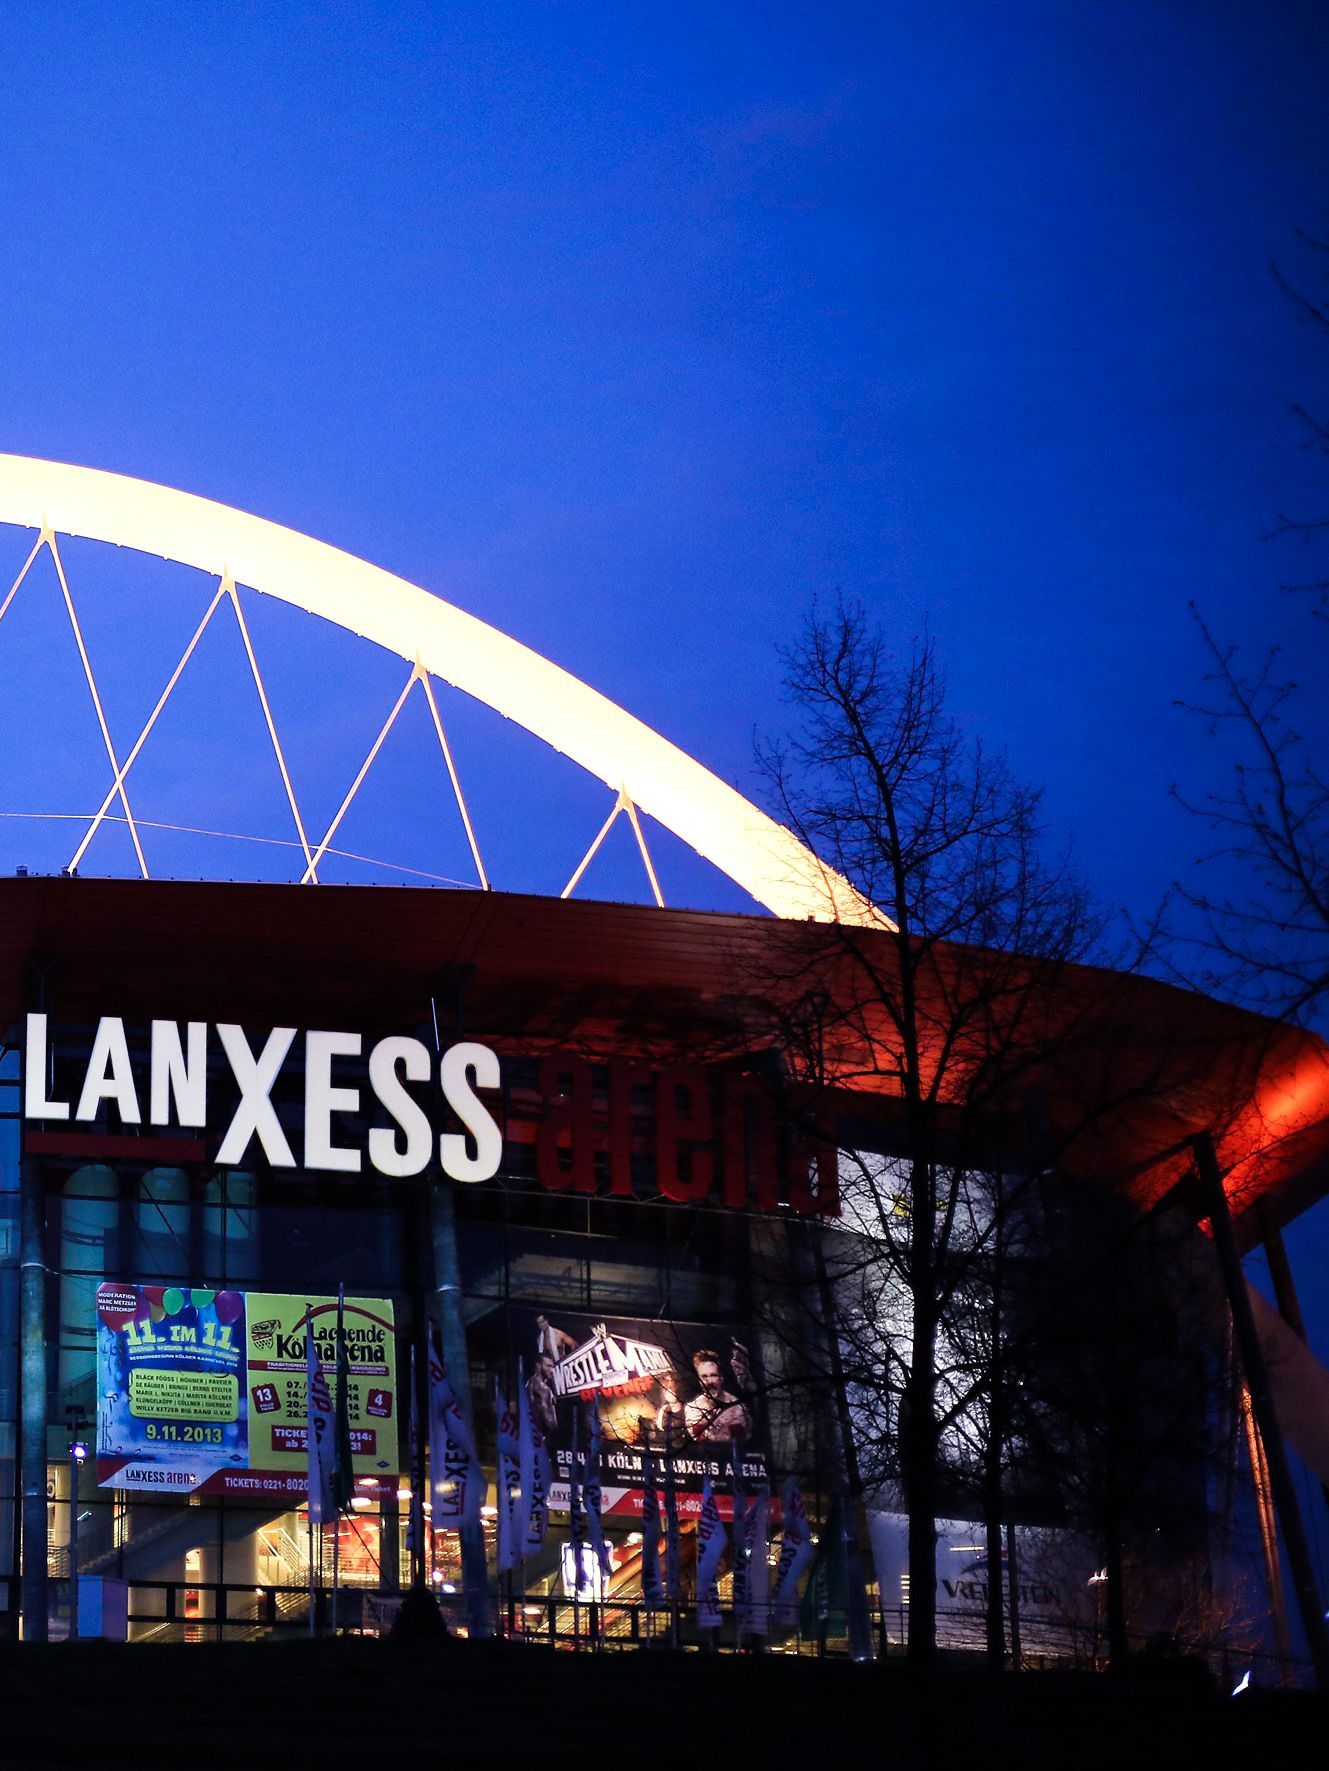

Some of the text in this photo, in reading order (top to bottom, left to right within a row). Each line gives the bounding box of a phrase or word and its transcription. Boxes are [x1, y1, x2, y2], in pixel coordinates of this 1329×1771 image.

[25, 1012, 841, 1216] LANXESS arena
[122, 1319, 240, 1353] 11. IM 11.
[256, 1388, 272, 1402] 13
[374, 1394, 383, 1406] 4
[146, 1424, 223, 1443] 9.11.2013
[608, 1451, 643, 1471] KÖLN
[725, 1462, 768, 1478] AENA
[125, 1469, 165, 1484] LANXESS
[224, 1477, 262, 1489] TICKETS:
